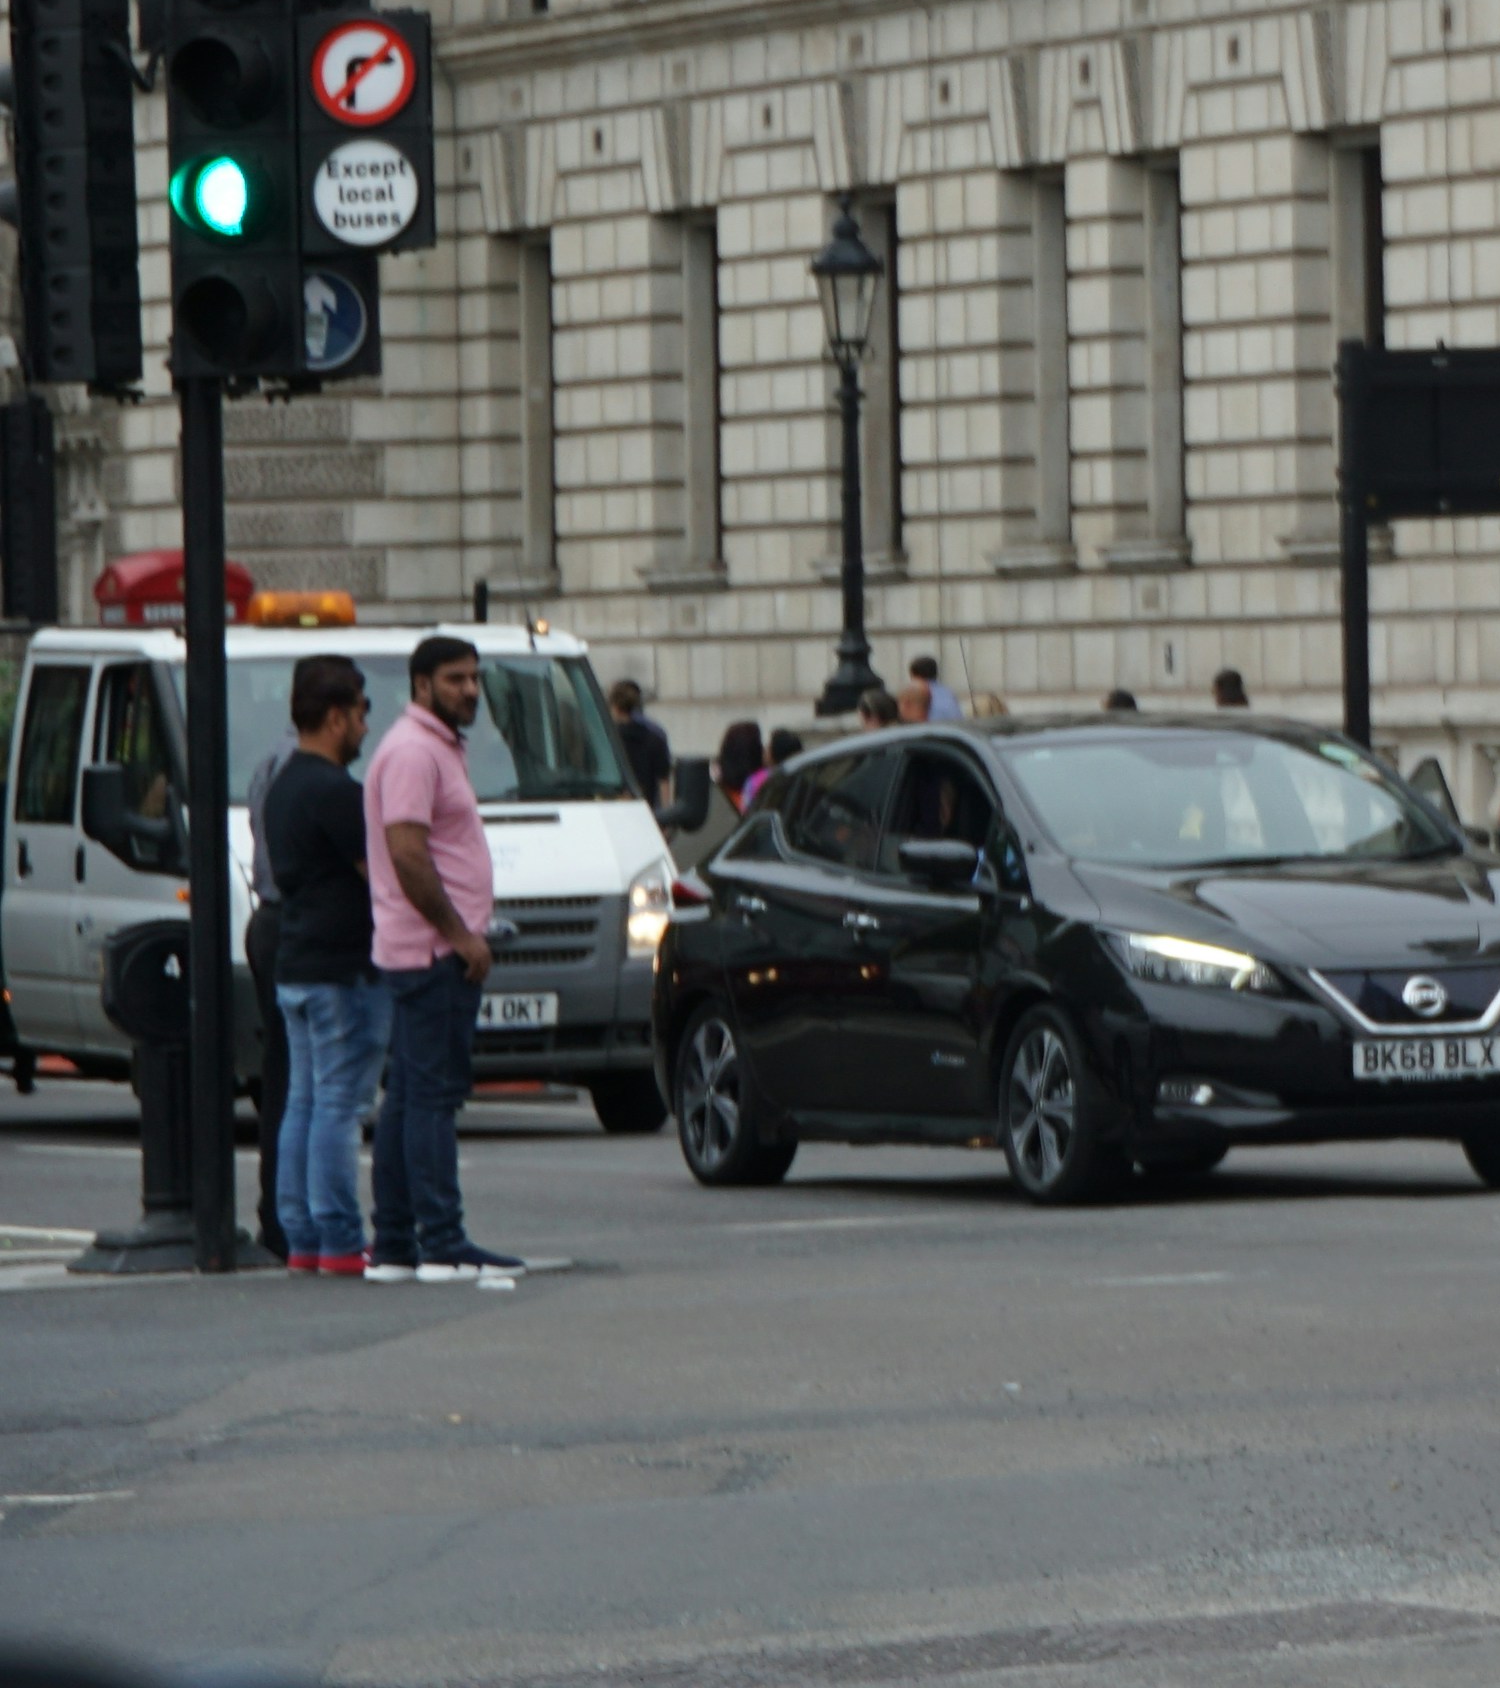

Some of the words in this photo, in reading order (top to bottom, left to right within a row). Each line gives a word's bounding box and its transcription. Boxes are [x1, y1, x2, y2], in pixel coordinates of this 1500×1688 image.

[326, 158, 406, 180] Except
[338, 181, 395, 204] local
[333, 209, 401, 229] buses
[502, 996, 545, 1021] OKT
[1362, 1040, 1435, 1072] BK68
[1444, 1036, 1495, 1068] BLX
